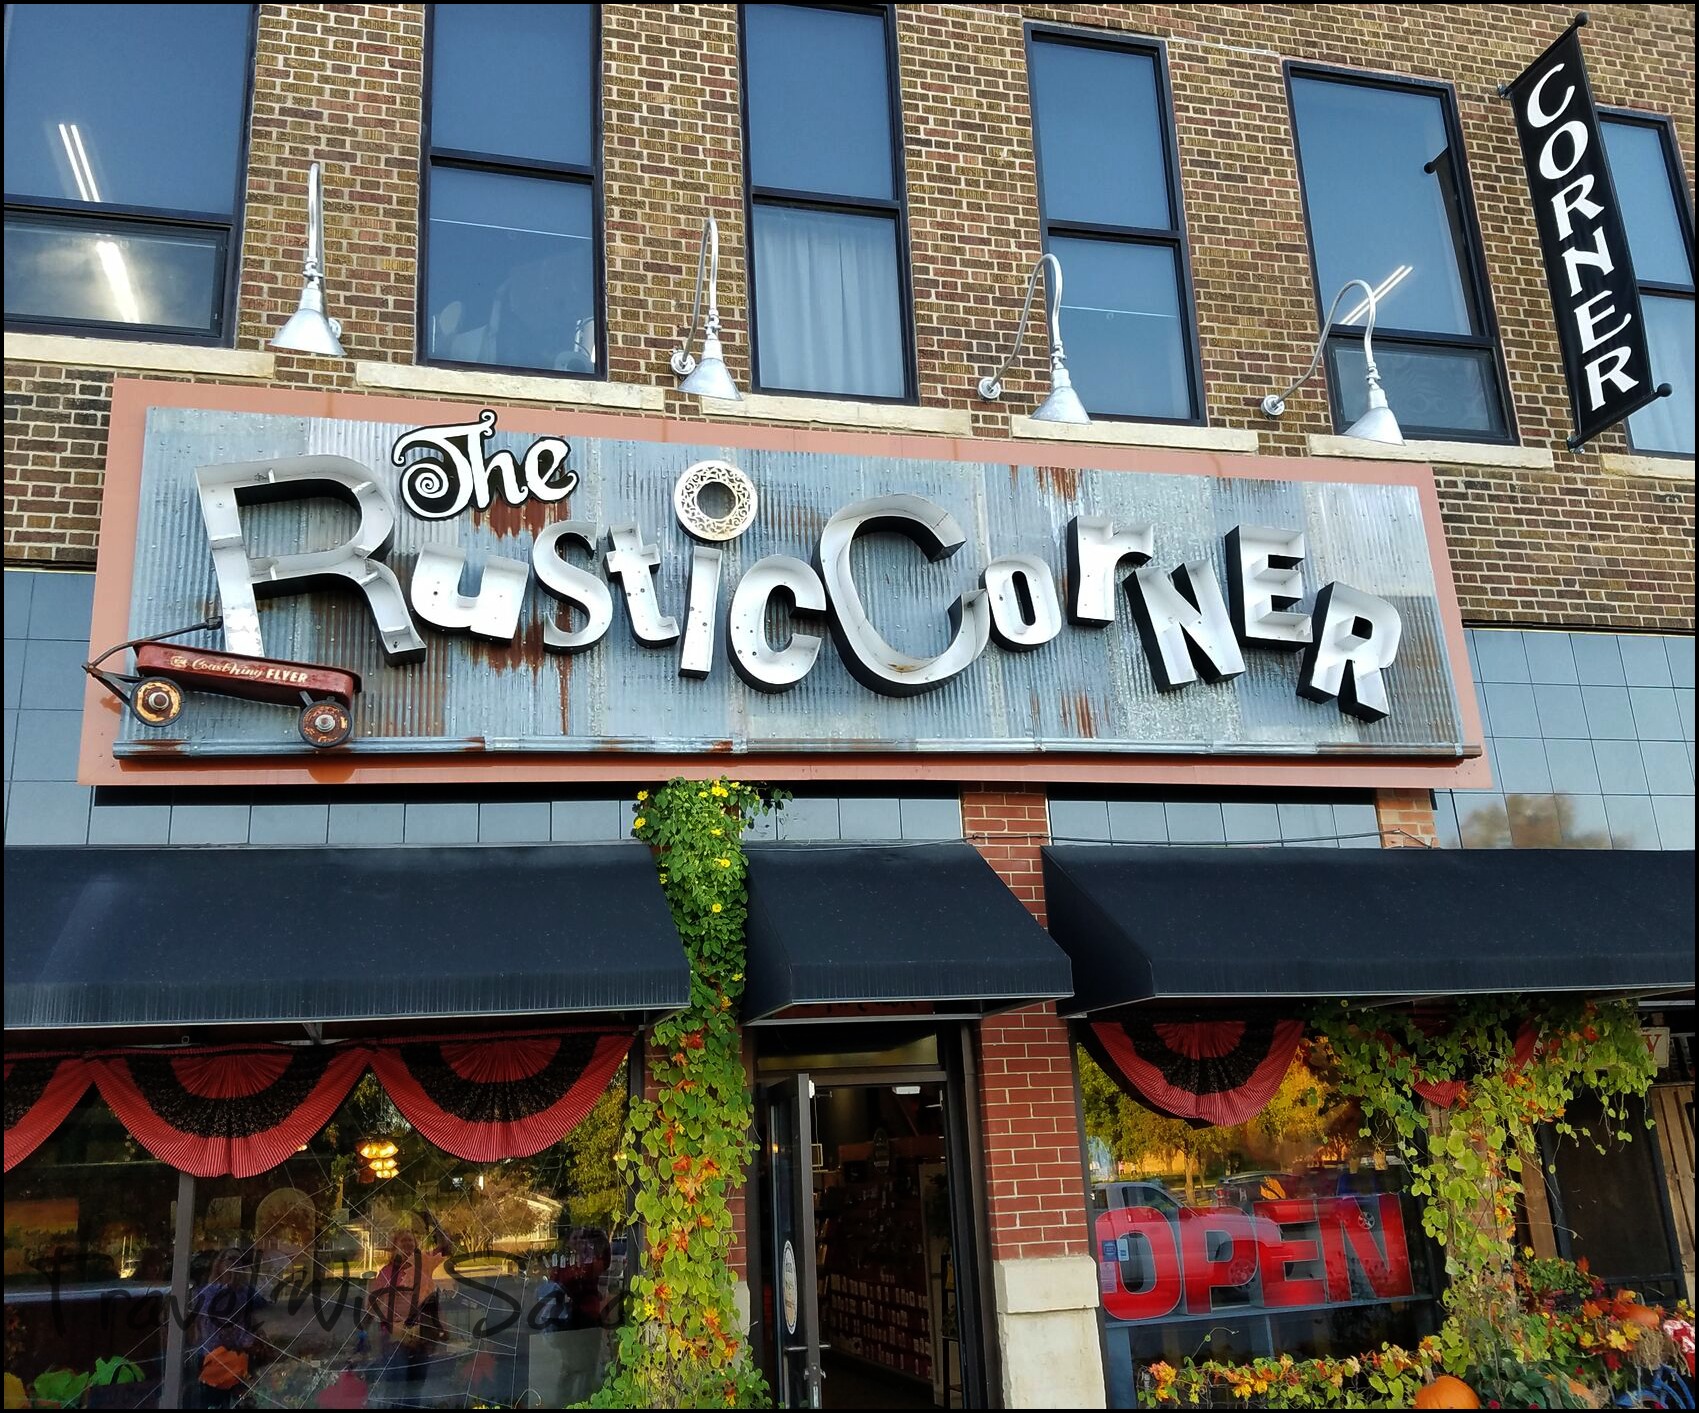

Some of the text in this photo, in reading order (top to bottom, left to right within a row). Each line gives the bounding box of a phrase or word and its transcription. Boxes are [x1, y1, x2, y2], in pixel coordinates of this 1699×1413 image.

[1526, 62, 1640, 412] CORNER
[392, 409, 580, 521] The
[195, 454, 827, 692] Rustic
[265, 668, 309, 683] FLYER
[1096, 1193, 1415, 1321] OPEN
